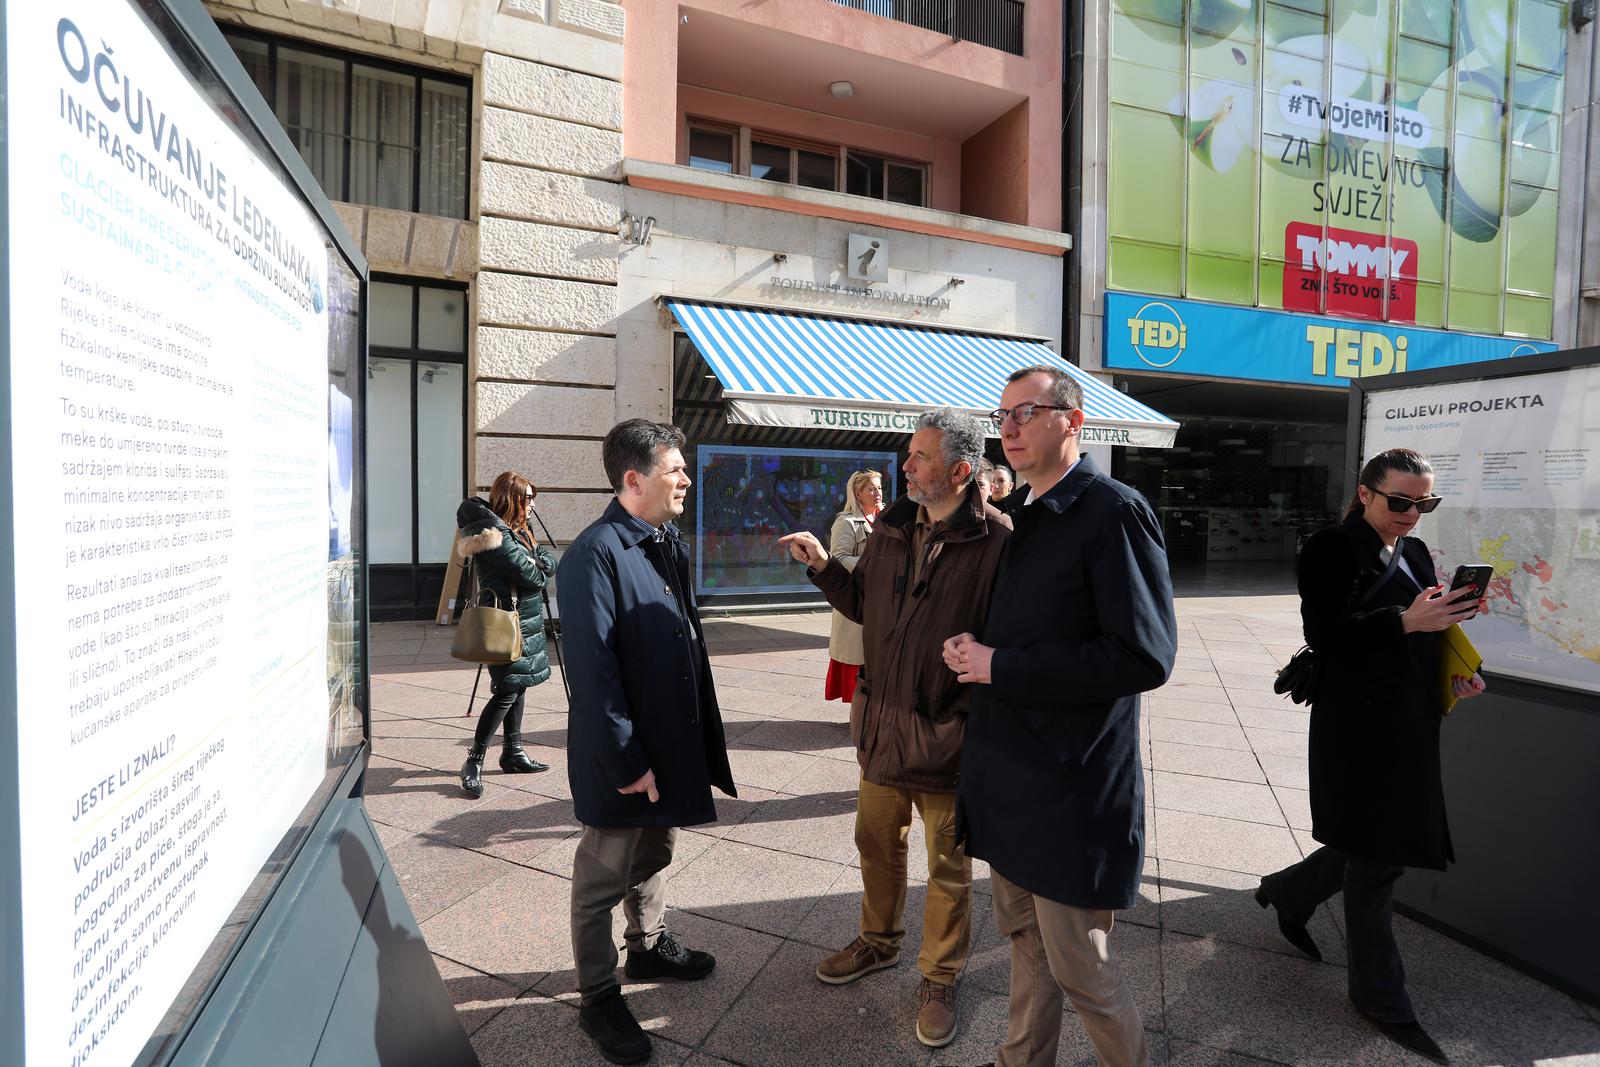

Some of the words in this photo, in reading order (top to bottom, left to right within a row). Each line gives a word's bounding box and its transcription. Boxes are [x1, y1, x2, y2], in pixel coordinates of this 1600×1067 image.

[1288, 94, 1423, 139] #TvojeMisto
[57, 17, 226, 212] OČUVANJE
[232, 184, 312, 289] LEDENJAKA
[1280, 133, 1312, 169] ZA
[1327, 147, 1426, 188] DNEVNO
[59, 88, 213, 237] INFRASTRUKTURA
[216, 218, 231, 249] ZA
[233, 234, 272, 281] ODRŽIVU
[59, 152, 134, 221] GLACIER
[59, 191, 173, 275] SUSTAINABLE
[1296, 234, 1410, 281] TOMMY
[61, 268, 92, 295] Voda
[96, 283, 118, 308] koja
[770, 276, 841, 296] TOURIST
[844, 285, 951, 310] INFORMATION
[1333, 278, 1359, 296] ŠTO
[61, 297, 98, 327] Rijeke
[108, 317, 127, 336] šire
[1127, 318, 1187, 350] TEDi
[60, 328, 159, 372] fizikalno-kemijske
[1306, 325, 1408, 378] TEDi
[59, 397, 78, 416] To
[81, 406, 94, 419] su
[98, 404, 128, 424] krške
[129, 413, 155, 430] vode,
[810, 407, 920, 430] TURISTIČK
[1082, 427, 1130, 443] ENTAR
[1384, 403, 1443, 420] CILJEVI
[1448, 394, 1545, 415] PROJEKTA
[1384, 421, 1414, 433] Project
[1416, 420, 1461, 431] objectives
[62, 430, 96, 448] meke
[99, 432, 113, 449] do
[118, 436, 161, 455] umjereno
[62, 458, 122, 480] sadržajem
[126, 461, 157, 479] klorida
[64, 486, 124, 504] minimalne
[127, 486, 188, 504] koncentracije
[65, 515, 96, 534] nizak
[100, 514, 122, 530] nivo
[125, 511, 165, 528] sadržaja
[66, 548, 76, 568] je
[80, 537, 150, 560] karakteristika
[67, 575, 116, 601] Rezultati
[120, 570, 152, 589] analiza
[154, 563, 191, 580] kvalitete
[68, 611, 99, 632] nema
[104, 598, 143, 624] potrebe
[145, 594, 155, 608] za
[69, 637, 96, 660] vode
[100, 631, 122, 651] (kao
[125, 624, 139, 640] što
[143, 621, 151, 633] su
[69, 669, 78, 689] ili
[82, 653, 120, 683] slično).
[124, 649, 136, 664] To
[138, 641, 160, 659] znači
[163, 637, 174, 648] da
[70, 688, 109, 718] trebaju
[113, 655, 175, 697] upotrebljavati
[71, 710, 121, 746] kućanske
[124, 690, 157, 719] aparate
[160, 685, 169, 696] za
[72, 773, 115, 822] JESTE
[120, 764, 130, 787] LI
[134, 734, 176, 777] ZNALI?
[73, 835, 107, 874] Voda
[110, 827, 119, 842] s
[121, 784, 168, 835] izvorišta
[172, 766, 195, 792] šireg
[197, 737, 224, 772] riječkog
[74, 846, 131, 916] područja
[135, 815, 168, 851] dolazi
[171, 784, 200, 820] sasvim
[74, 872, 130, 951] pogodna
[134, 862, 146, 883] za
[150, 837, 175, 871] piće,
[178, 810, 202, 839] stoga
[204, 800, 211, 819] je
[213, 790, 220, 805] za
[72, 930, 111, 980] njenu
[113, 858, 183, 934] zdravstvenu
[184, 808, 227, 860] ispravnost
[71, 939, 128, 1013] dovoljan
[131, 902, 162, 943] samo
[165, 851, 208, 911] postupak
[68, 944, 151, 1047] dezinfekcije
[153, 890, 195, 948] klorovim
